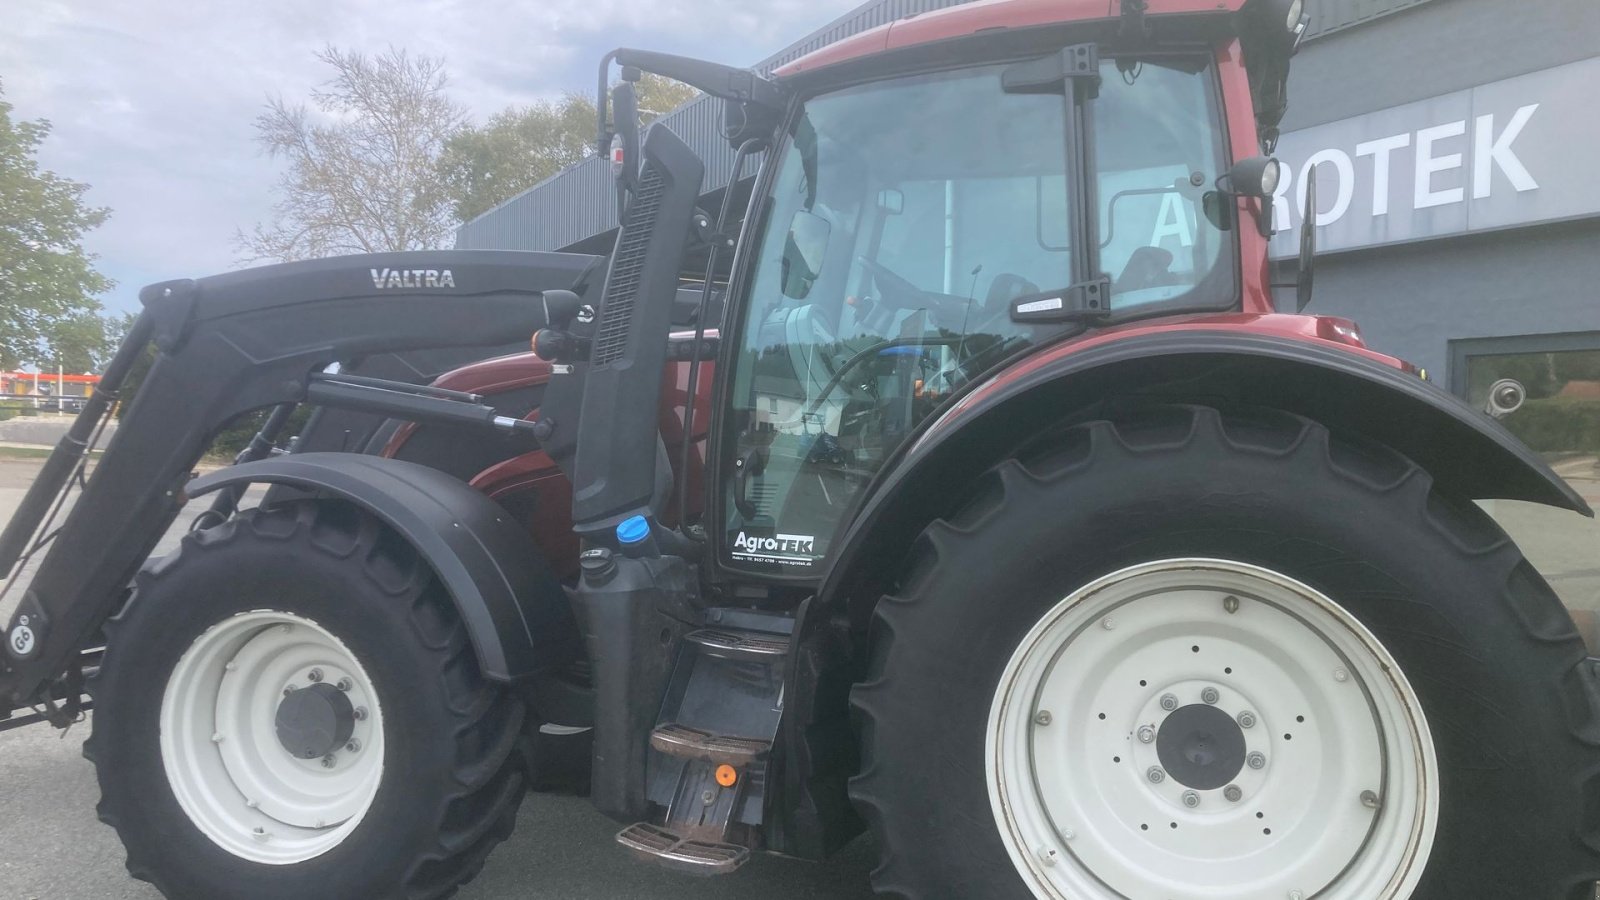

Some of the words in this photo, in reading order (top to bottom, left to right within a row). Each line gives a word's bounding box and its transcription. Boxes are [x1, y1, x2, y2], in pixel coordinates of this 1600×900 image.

[1150, 104, 1540, 247] AROTEK
[370, 268, 456, 289] VALTRA
[734, 531, 814, 553] AgroTEK
[14, 628, 31, 651] G6
